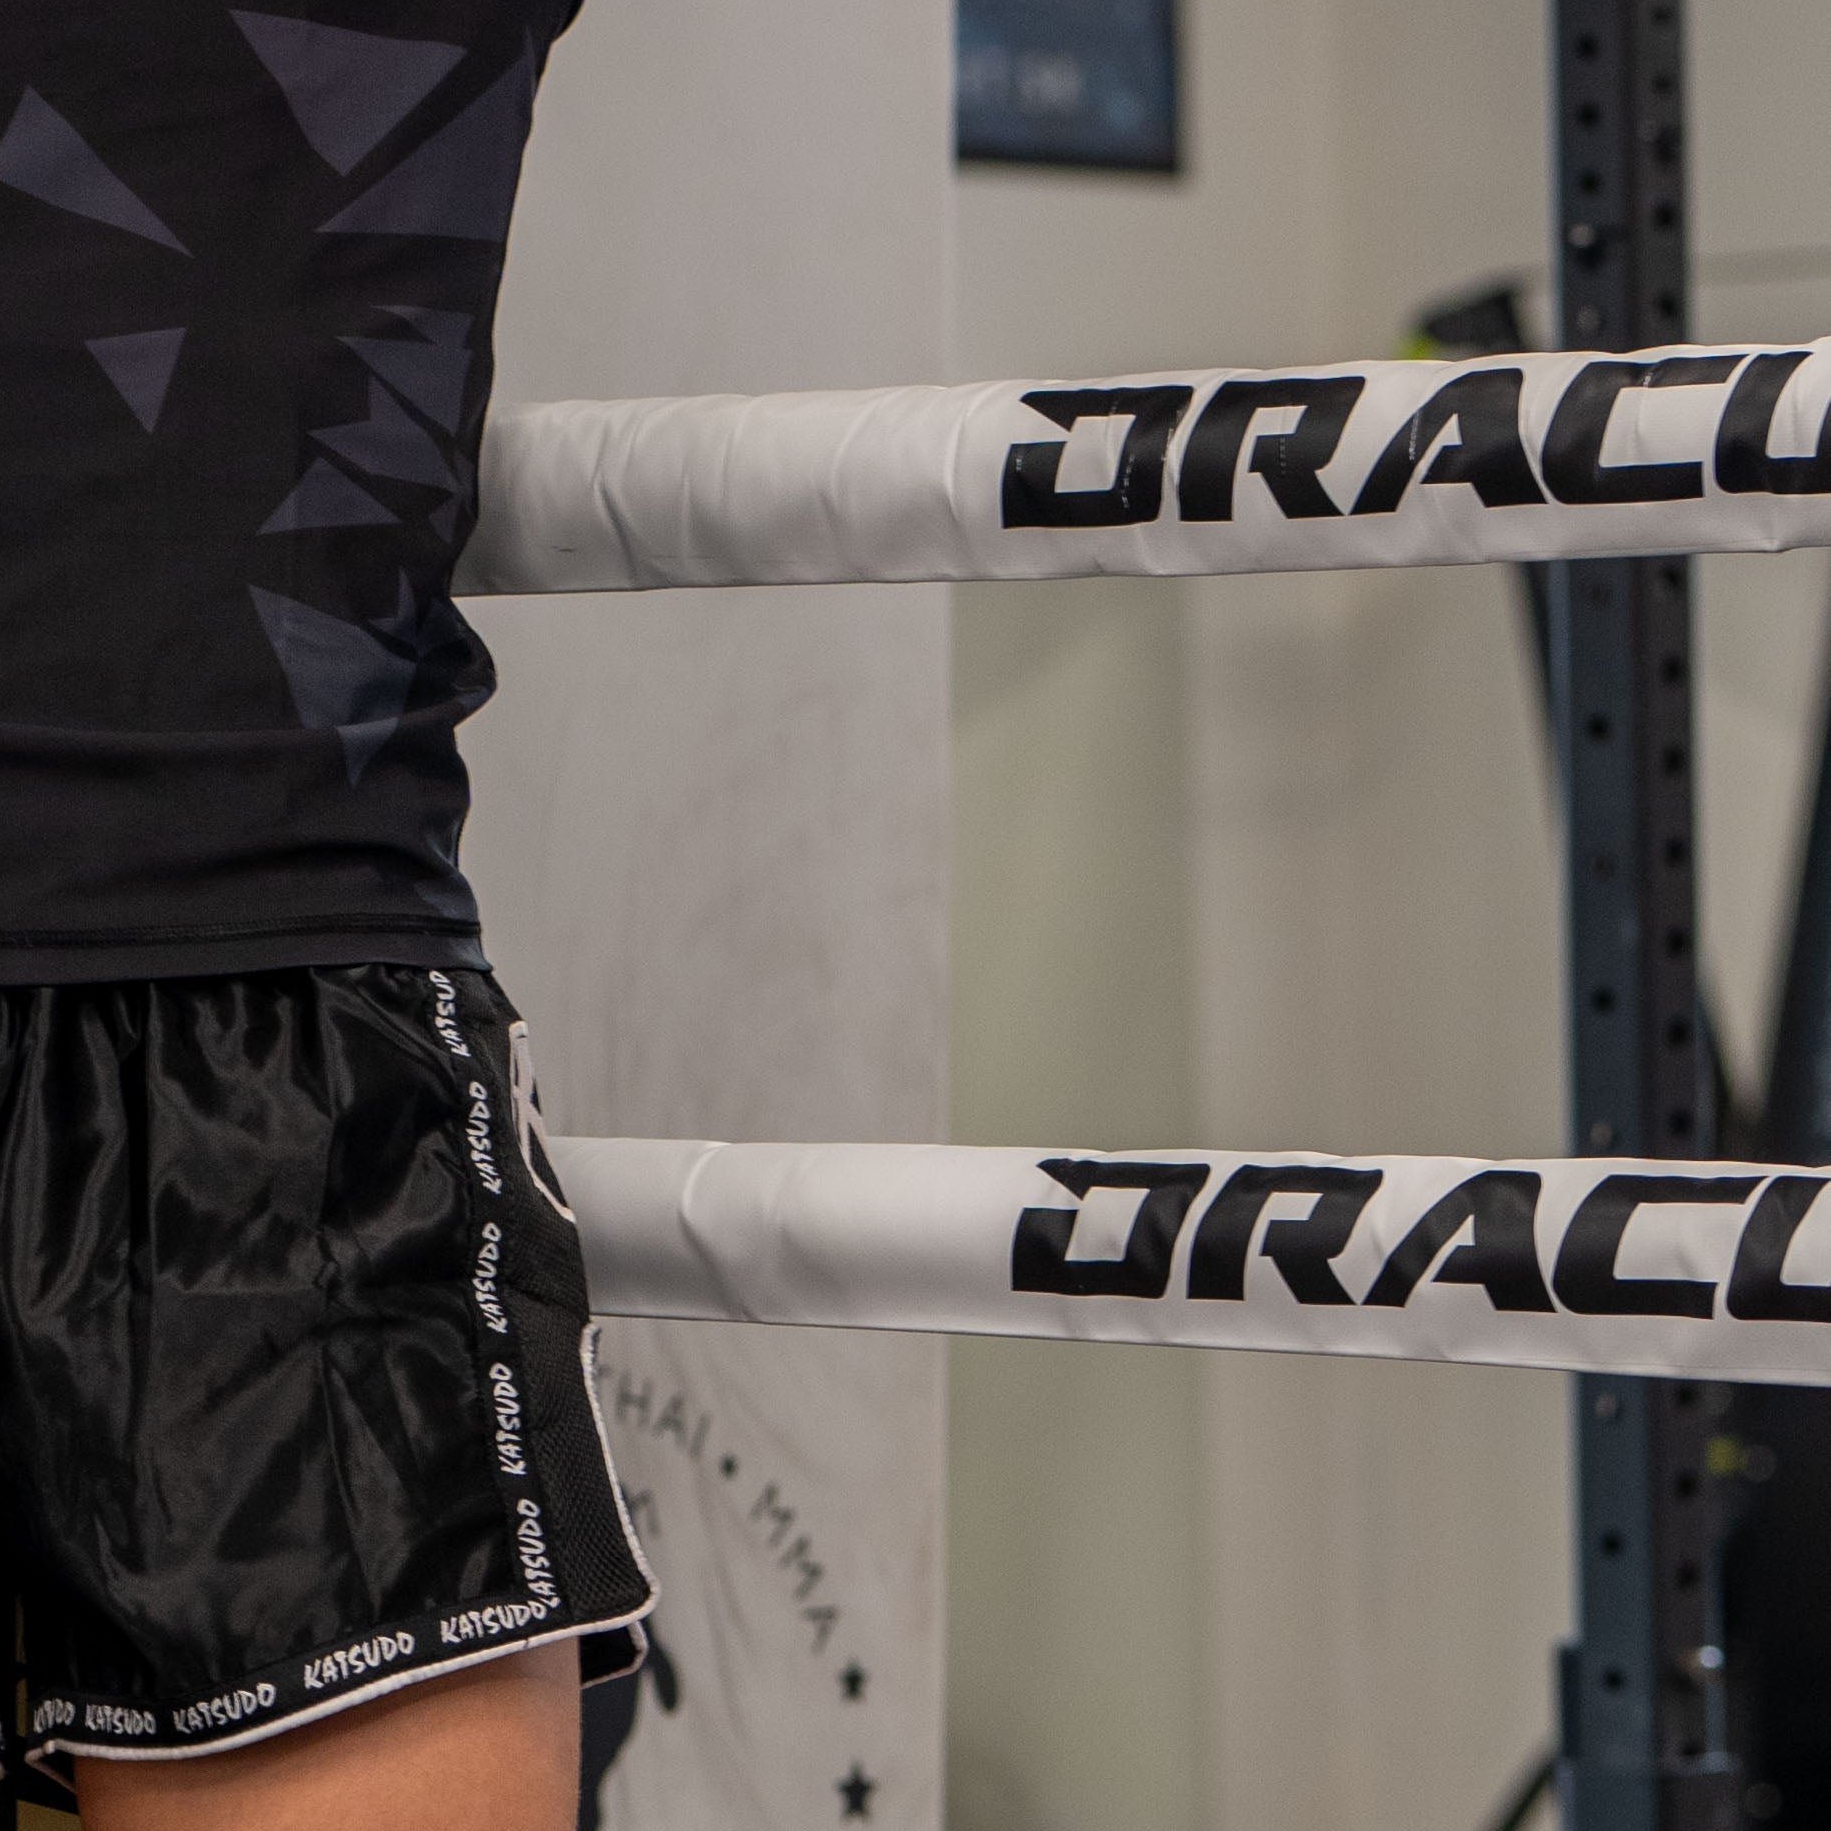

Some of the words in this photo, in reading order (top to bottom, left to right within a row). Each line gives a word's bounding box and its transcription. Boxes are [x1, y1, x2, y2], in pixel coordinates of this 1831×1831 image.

[466, 1081, 502, 1194] KATSUDO
[472, 1222, 509, 1334] KATSUDO
[489, 1362, 527, 1475] KATSUDO
[85, 1703, 157, 1735] KATSUDO
[173, 1682, 277, 1734] KATSUDO
[303, 1631, 416, 1690] KATSUDO
[440, 1599, 547, 1644] KATSUDO
